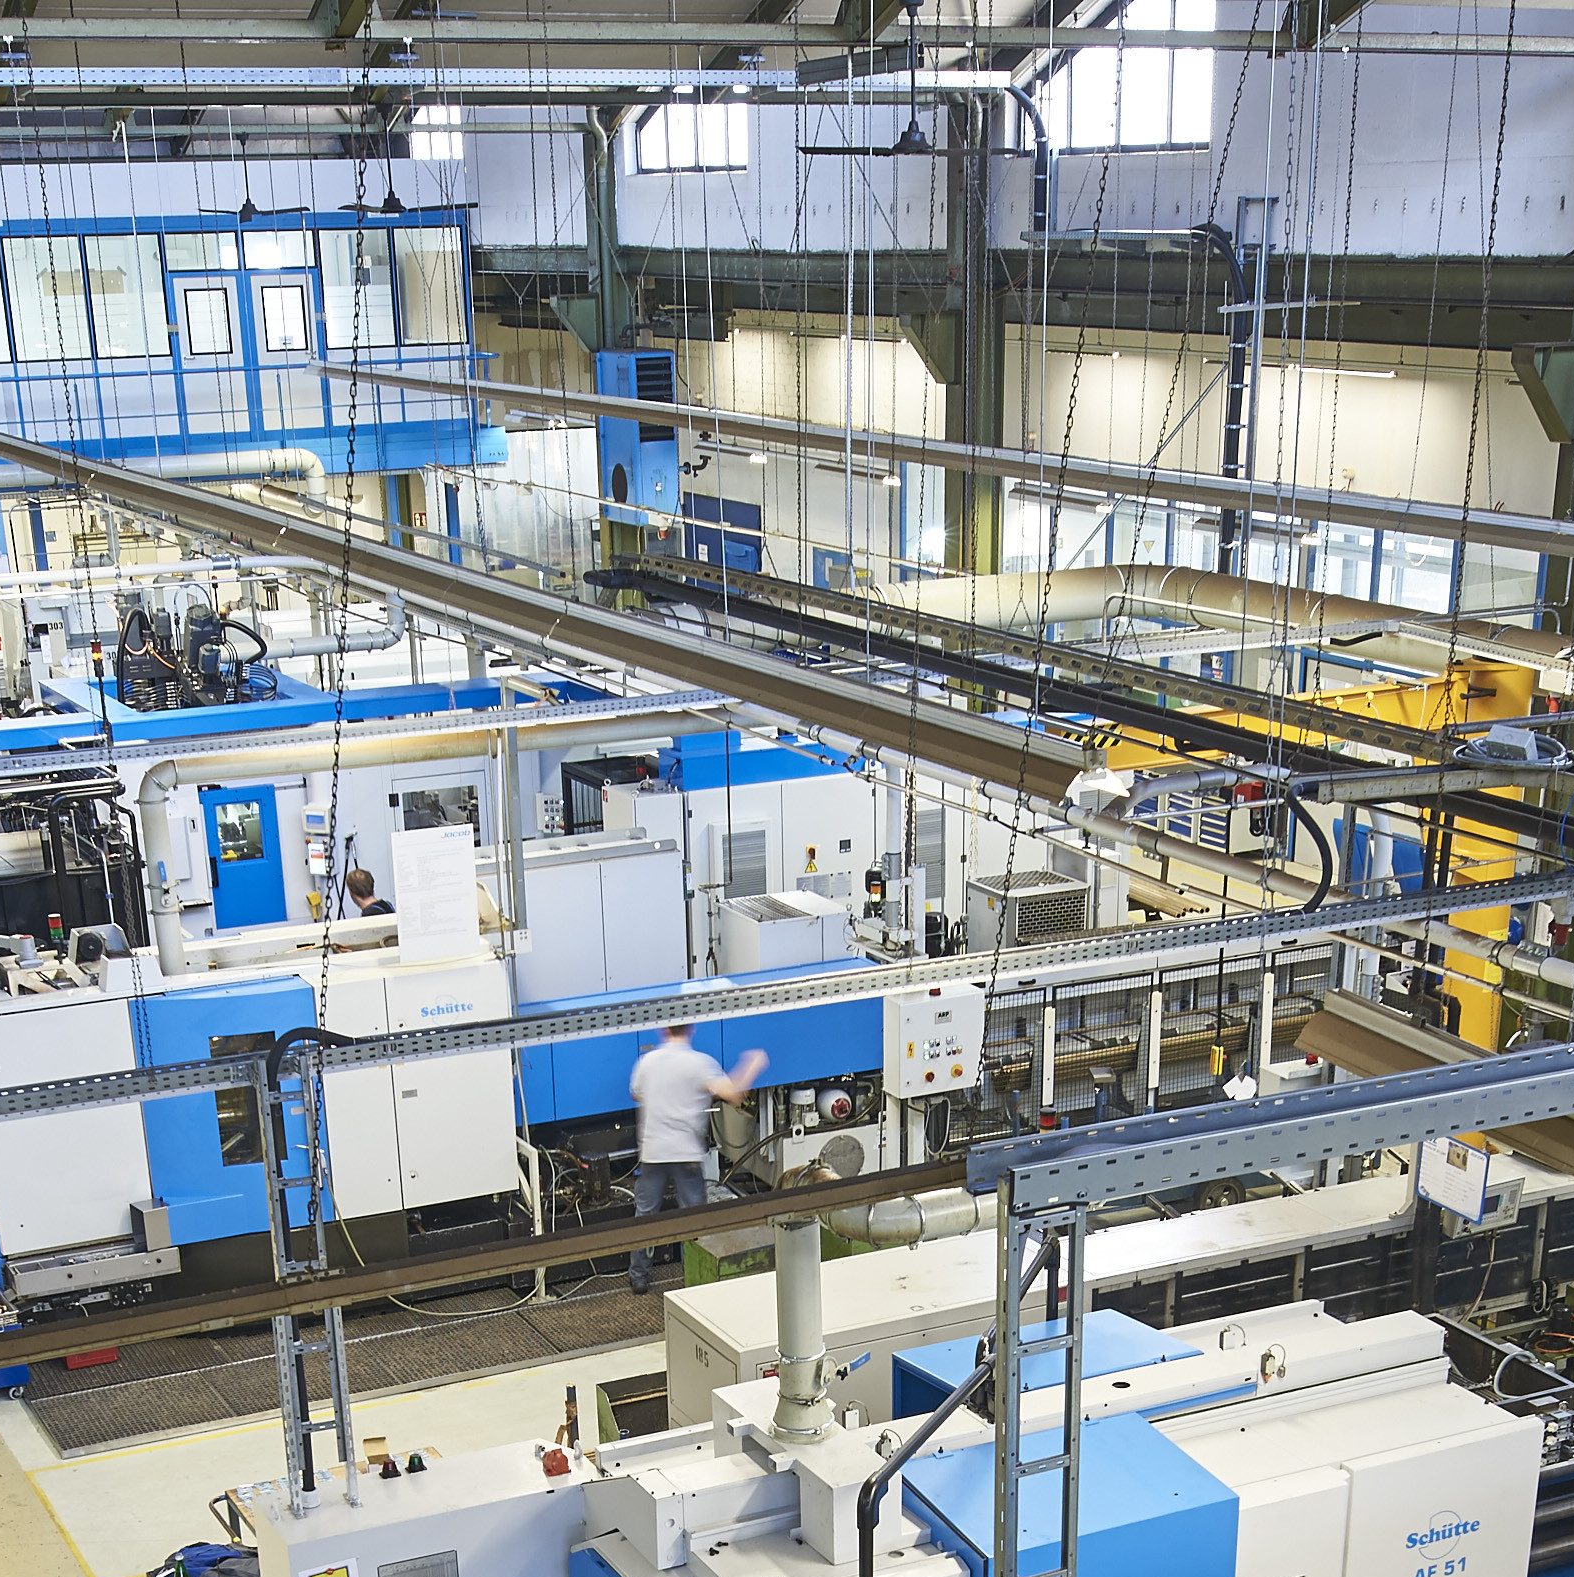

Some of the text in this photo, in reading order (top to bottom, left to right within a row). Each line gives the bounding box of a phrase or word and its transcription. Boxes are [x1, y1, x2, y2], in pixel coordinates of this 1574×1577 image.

[48, 621, 64, 631] 303
[106, 651, 118, 661] 30
[420, 1002, 474, 1017] Schütte
[695, 1343, 710, 1368] 185
[1405, 1519, 1481, 1549] Schütte
[1444, 1556, 1466, 1576] 51
